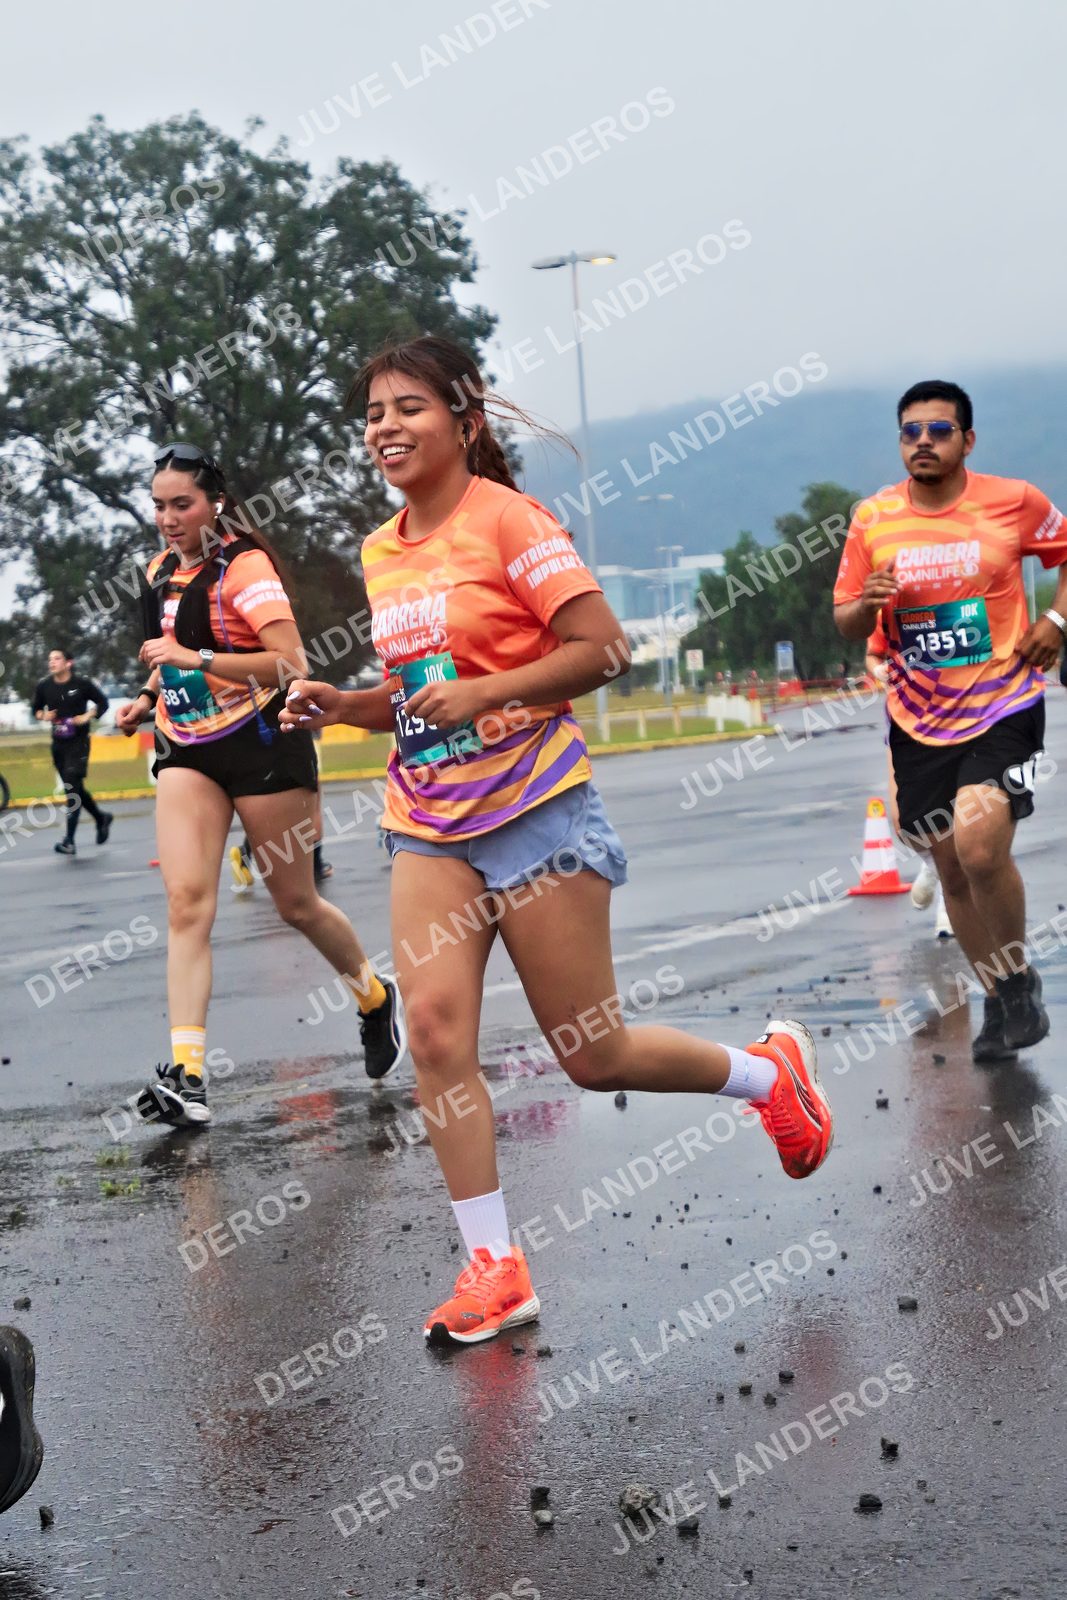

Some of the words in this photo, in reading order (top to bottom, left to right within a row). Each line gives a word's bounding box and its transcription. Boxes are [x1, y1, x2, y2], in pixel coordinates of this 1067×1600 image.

[507, 536, 569, 581] NUTRICIÓN
[896, 539, 980, 569] CARRERA
[897, 566, 960, 584] OMNILIFE
[371, 592, 447, 642] CARRERA
[960, 602, 979, 618] 10K
[916, 628, 969, 652] 1351
[424, 663, 447, 684] 10K
[396, 709, 438, 737] 129
